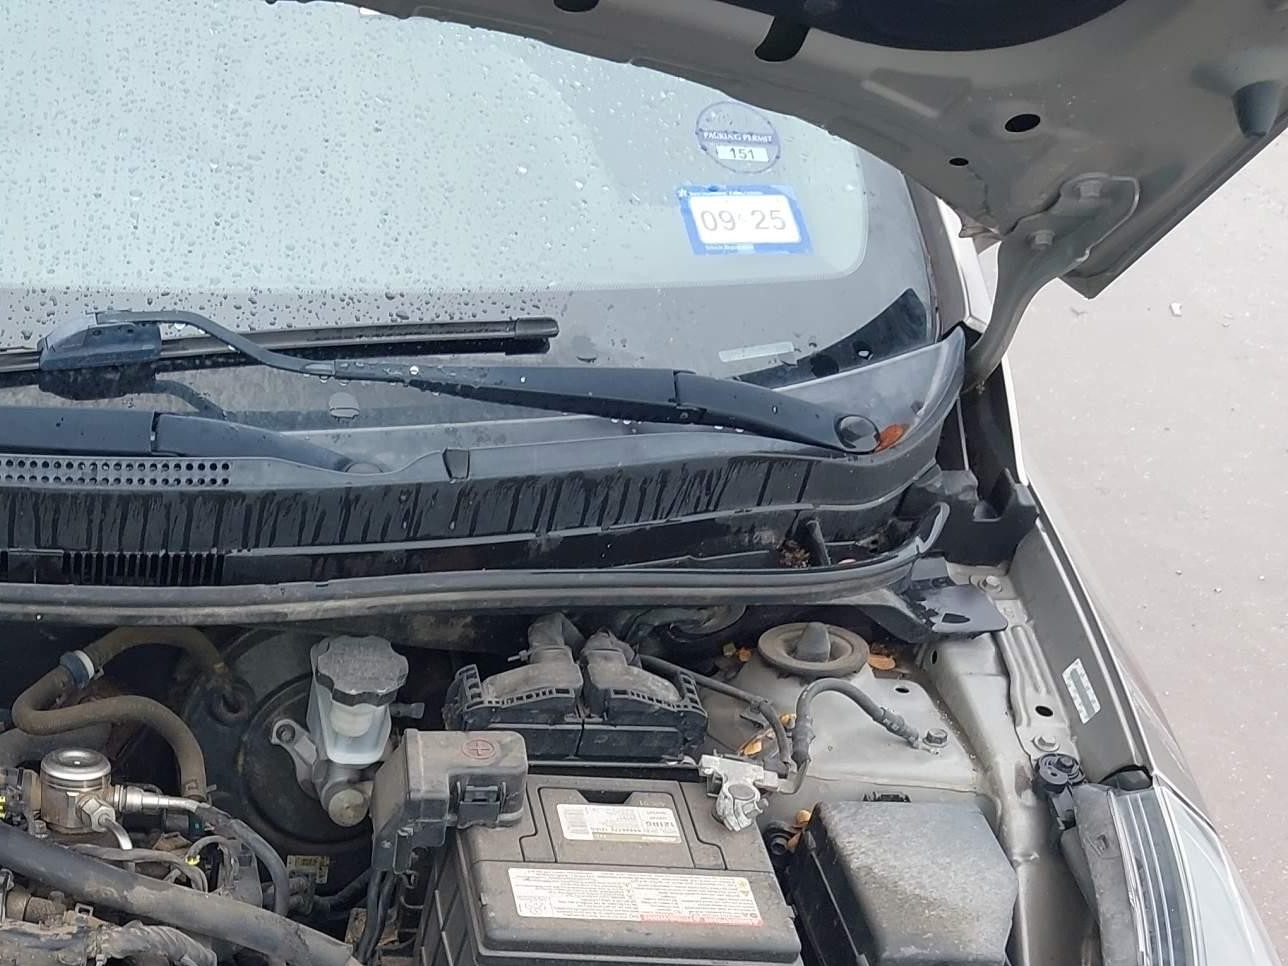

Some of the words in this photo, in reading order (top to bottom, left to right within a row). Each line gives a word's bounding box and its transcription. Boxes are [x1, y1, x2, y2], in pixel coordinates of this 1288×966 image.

[729, 147, 755, 160] 151
[700, 209, 736, 232] 09
[750, 209, 787, 231] 25
